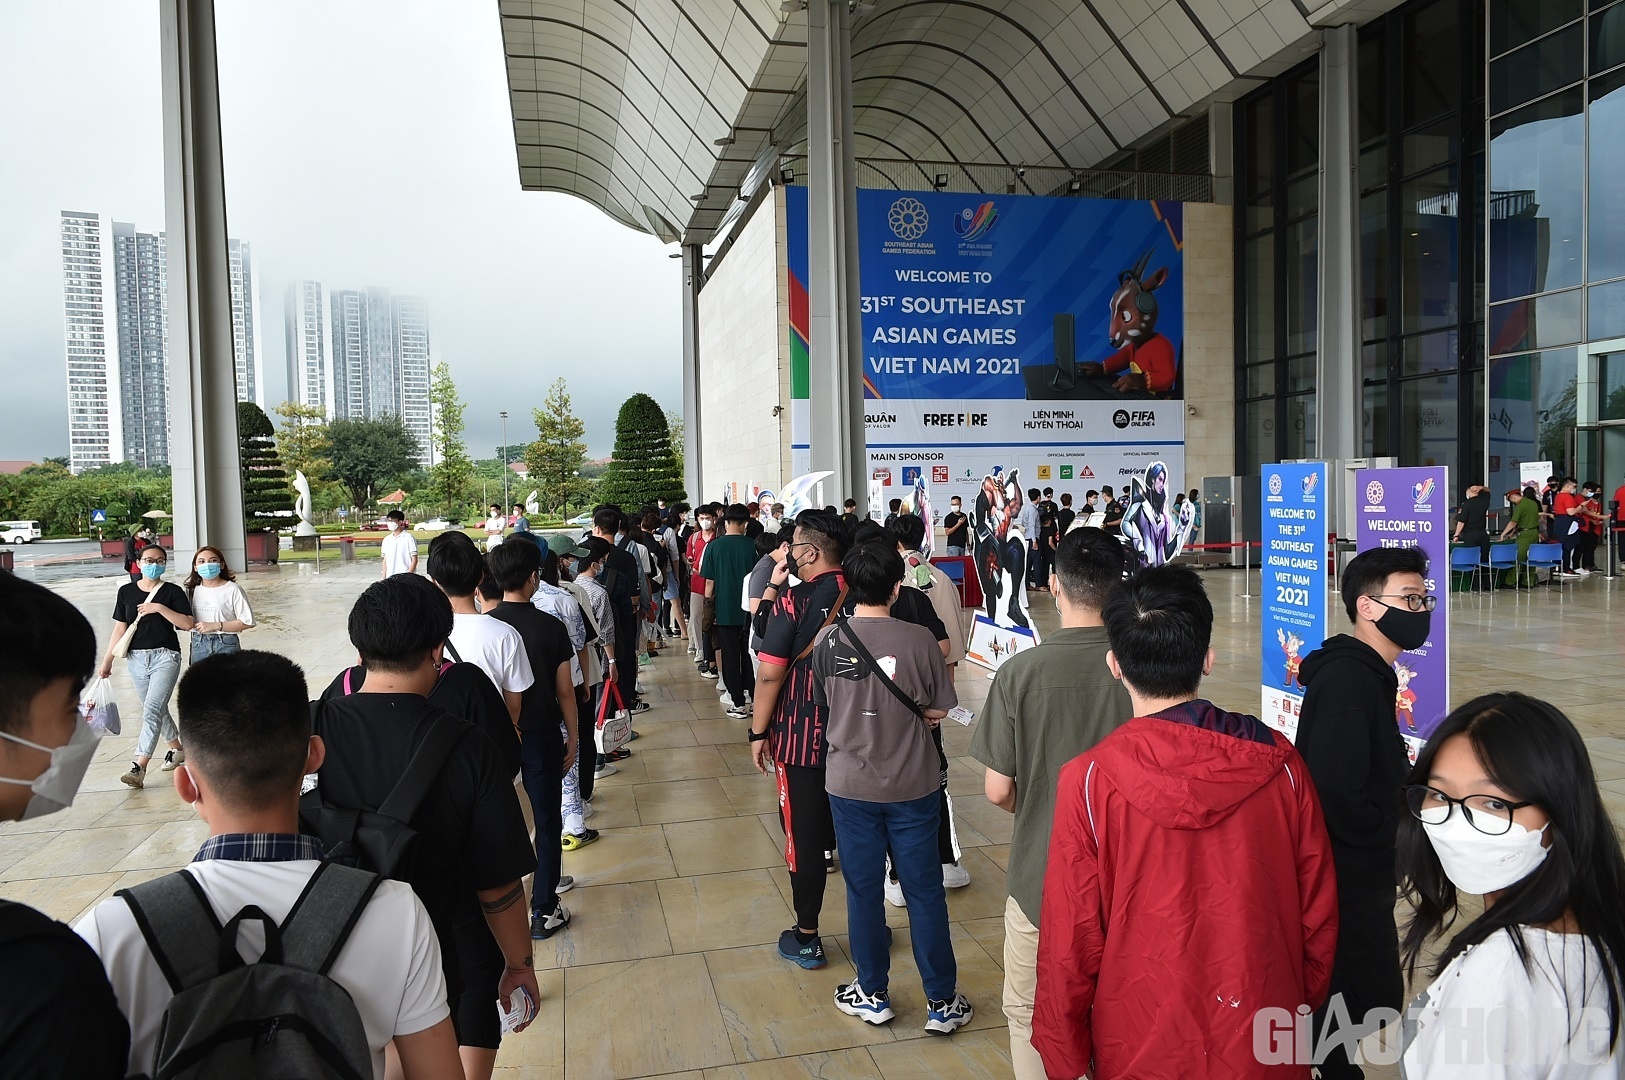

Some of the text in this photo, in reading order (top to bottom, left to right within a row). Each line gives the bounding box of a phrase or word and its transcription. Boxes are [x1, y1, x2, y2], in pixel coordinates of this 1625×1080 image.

[884, 241, 917, 249] SOUTHEAST
[895, 269, 992, 284] WELCOME TO
[901, 296, 1026, 316] SOUTHEAST
[872, 326, 1017, 345] ASIAN GAMES
[870, 356, 1020, 374] VIET NAM 2021
[923, 413, 955, 427] FREE
[1052, 410, 1074, 419] MINH
[1131, 411, 1155, 421] FIFA
[1056, 420, 1084, 430] THOẠI
[870, 453, 944, 461] MAIN SPONSOR
[1270, 508, 1316, 520] WELCOME TO
[1278, 525, 1306, 536] THE 31st
[1368, 519, 1432, 533] WELCOME TO
[1271, 539, 1314, 553] SOUTHEAST
[1380, 539, 1399, 549] THE
[1268, 555, 1318, 571] ASIAN GAMES
[1275, 572, 1310, 586] VIET NAM
[1276, 586, 1309, 607] 2021
